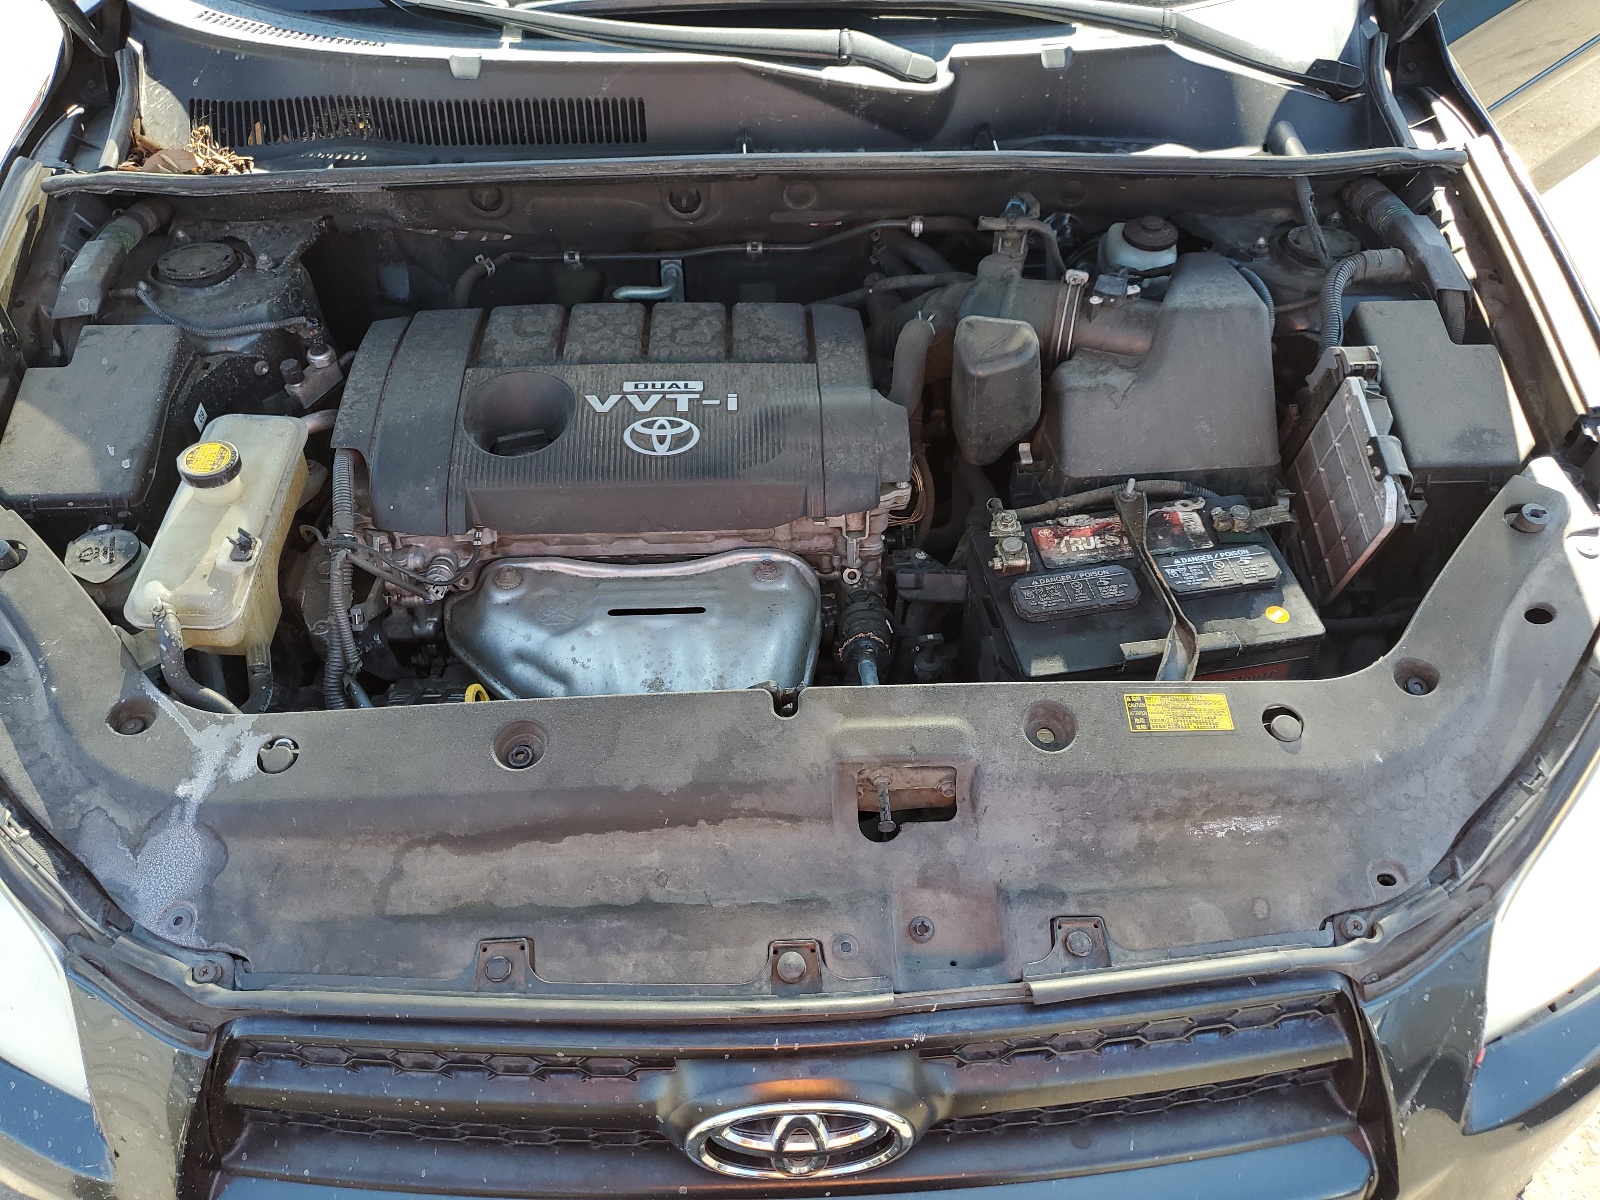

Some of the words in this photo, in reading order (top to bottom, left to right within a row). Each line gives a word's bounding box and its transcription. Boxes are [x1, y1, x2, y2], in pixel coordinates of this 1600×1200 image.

[633, 382, 696, 390] DUAL
[584, 393, 738, 413] VVT-i
[1180, 554, 1213, 564] DANGER
[1219, 549, 1250, 558] POISON
[1039, 574, 1072, 584] DANGER
[1079, 569, 1110, 579] POISON
